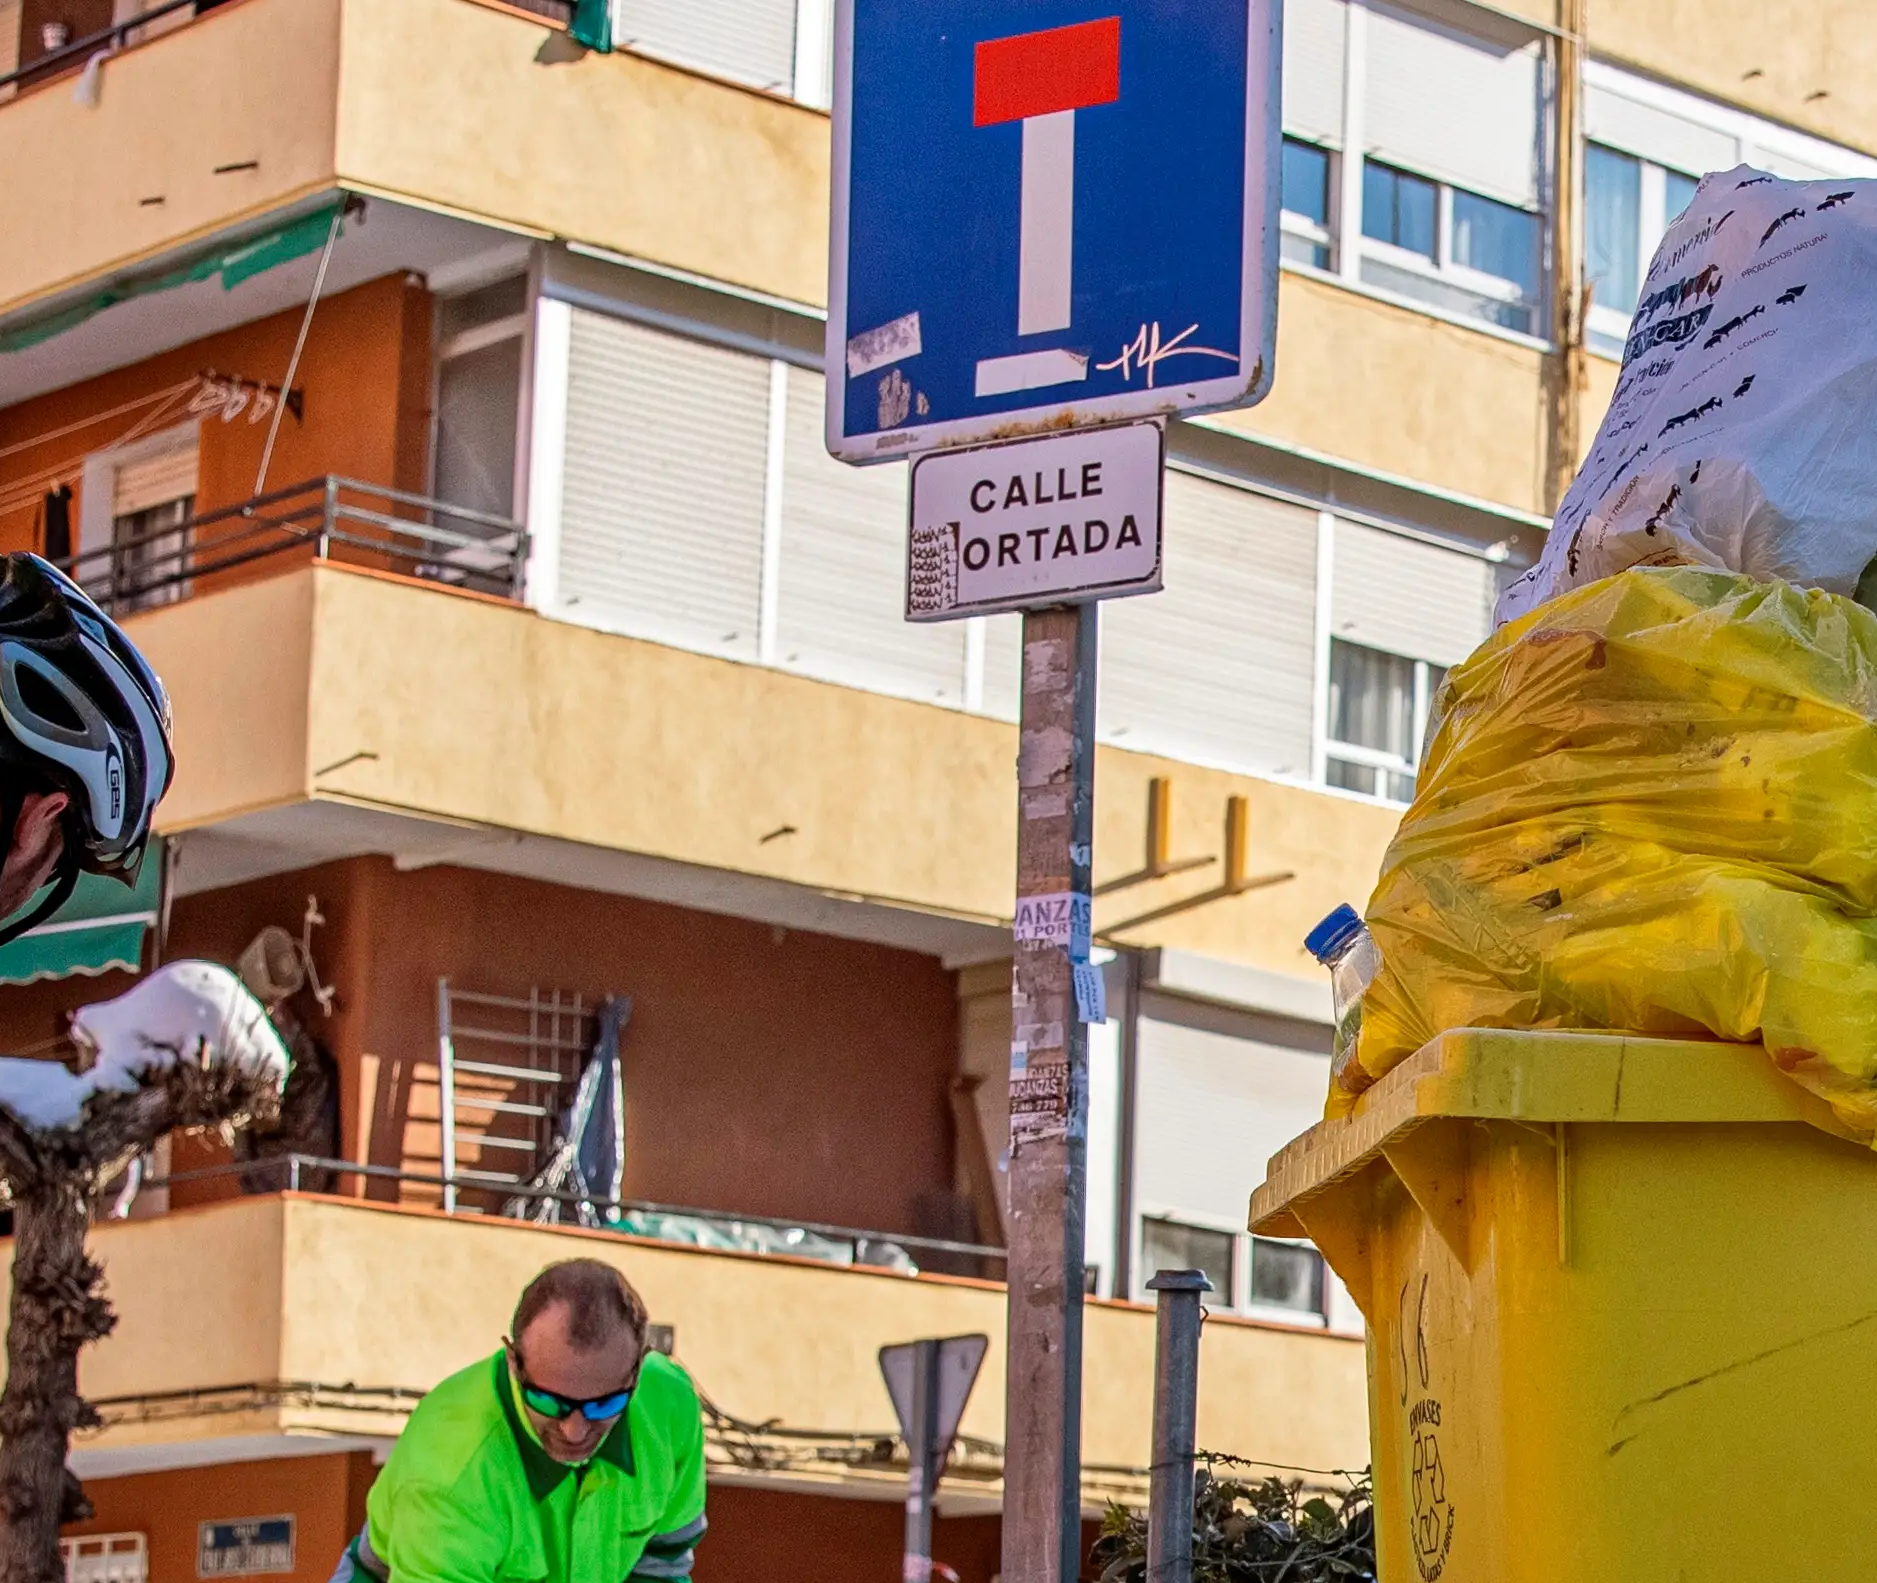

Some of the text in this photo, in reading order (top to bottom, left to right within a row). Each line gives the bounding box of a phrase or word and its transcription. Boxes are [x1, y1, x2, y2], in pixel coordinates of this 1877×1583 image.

[1741, 249, 1793, 280] PRODUCTOS
[970, 462, 1103, 513] CALLE
[963, 515, 1142, 571] ORTADA
[1015, 899, 1091, 927] ANZAS
[1409, 1398, 1442, 1437] ENVASES
[1443, 1503, 1456, 1556] BRICK
